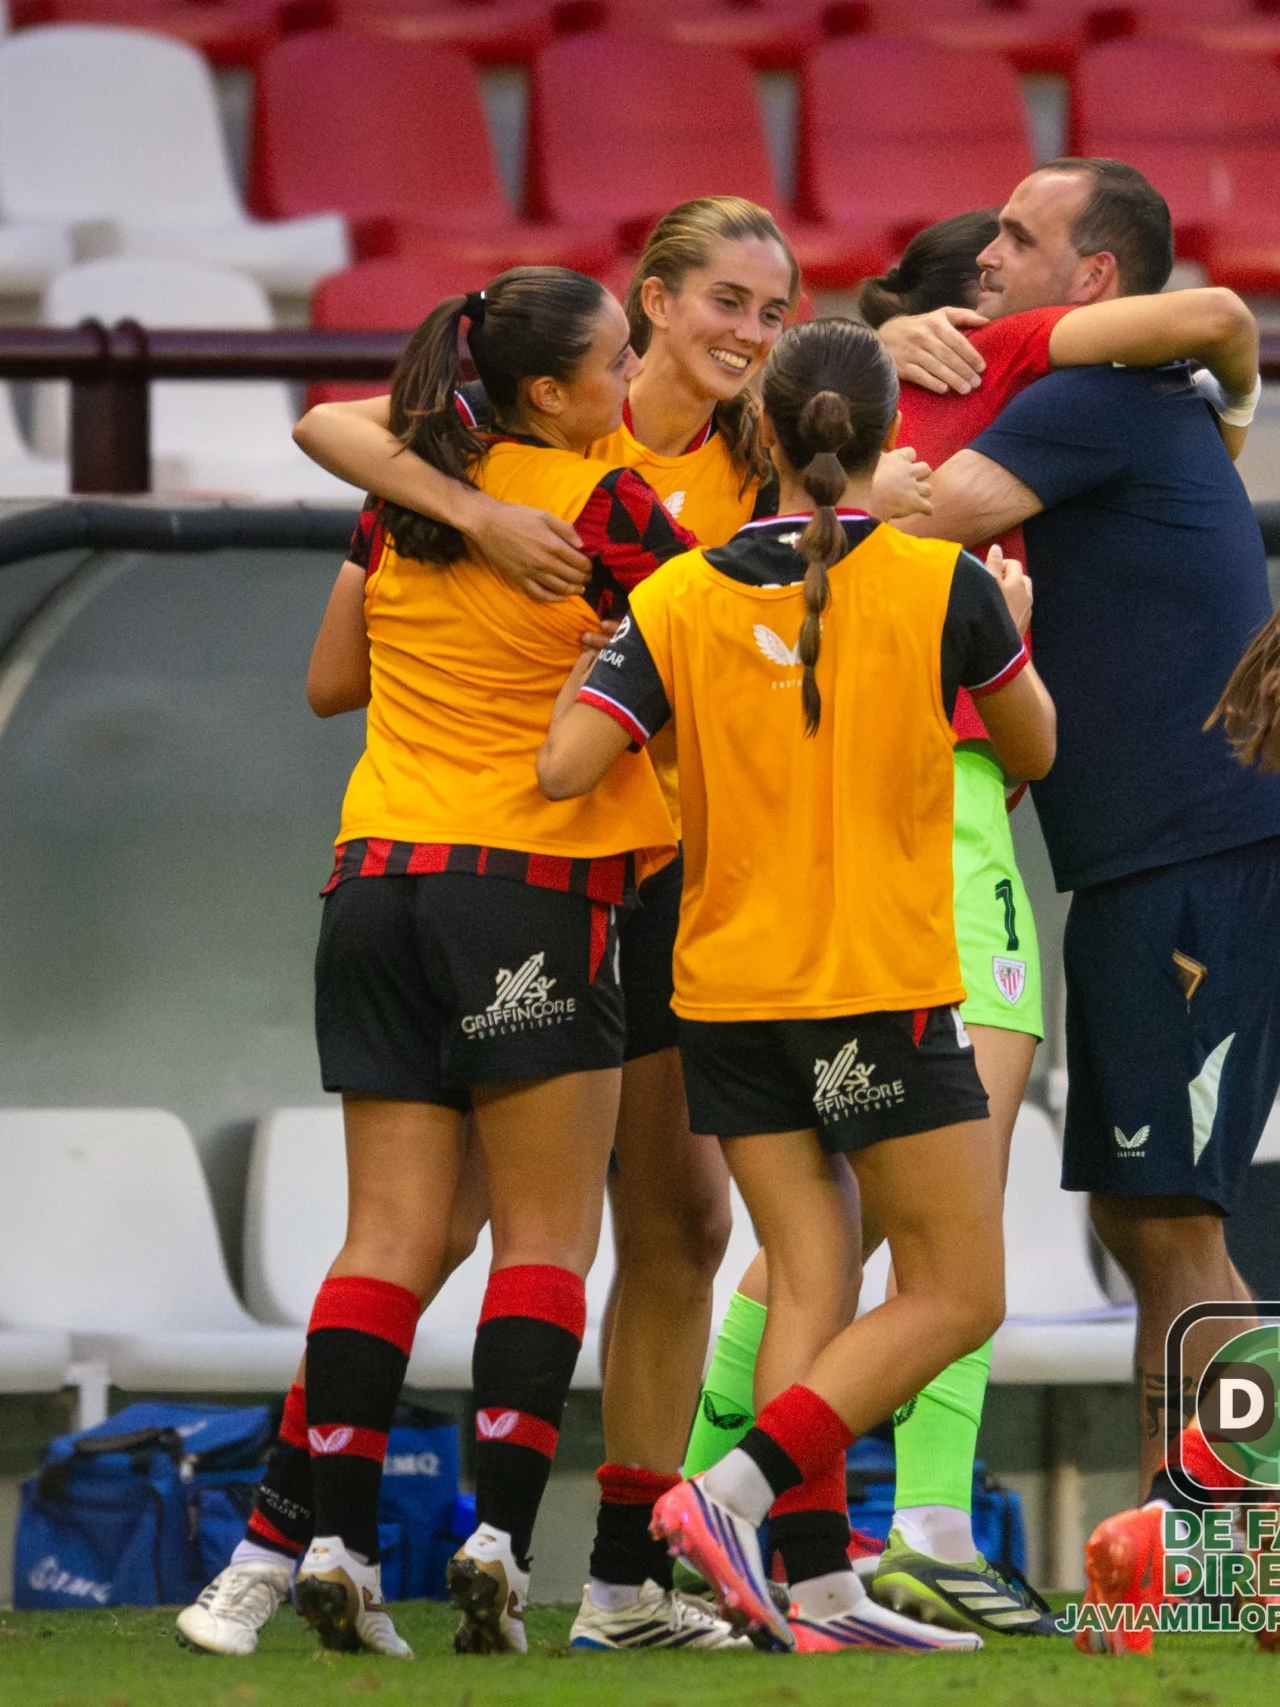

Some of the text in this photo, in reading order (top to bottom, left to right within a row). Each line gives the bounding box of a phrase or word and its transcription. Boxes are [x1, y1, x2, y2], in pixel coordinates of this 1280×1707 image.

[995, 878, 1019, 951] 1
[461, 997, 577, 1034] GRIFFINCORE
[814, 1079, 906, 1115] FFINCORE
